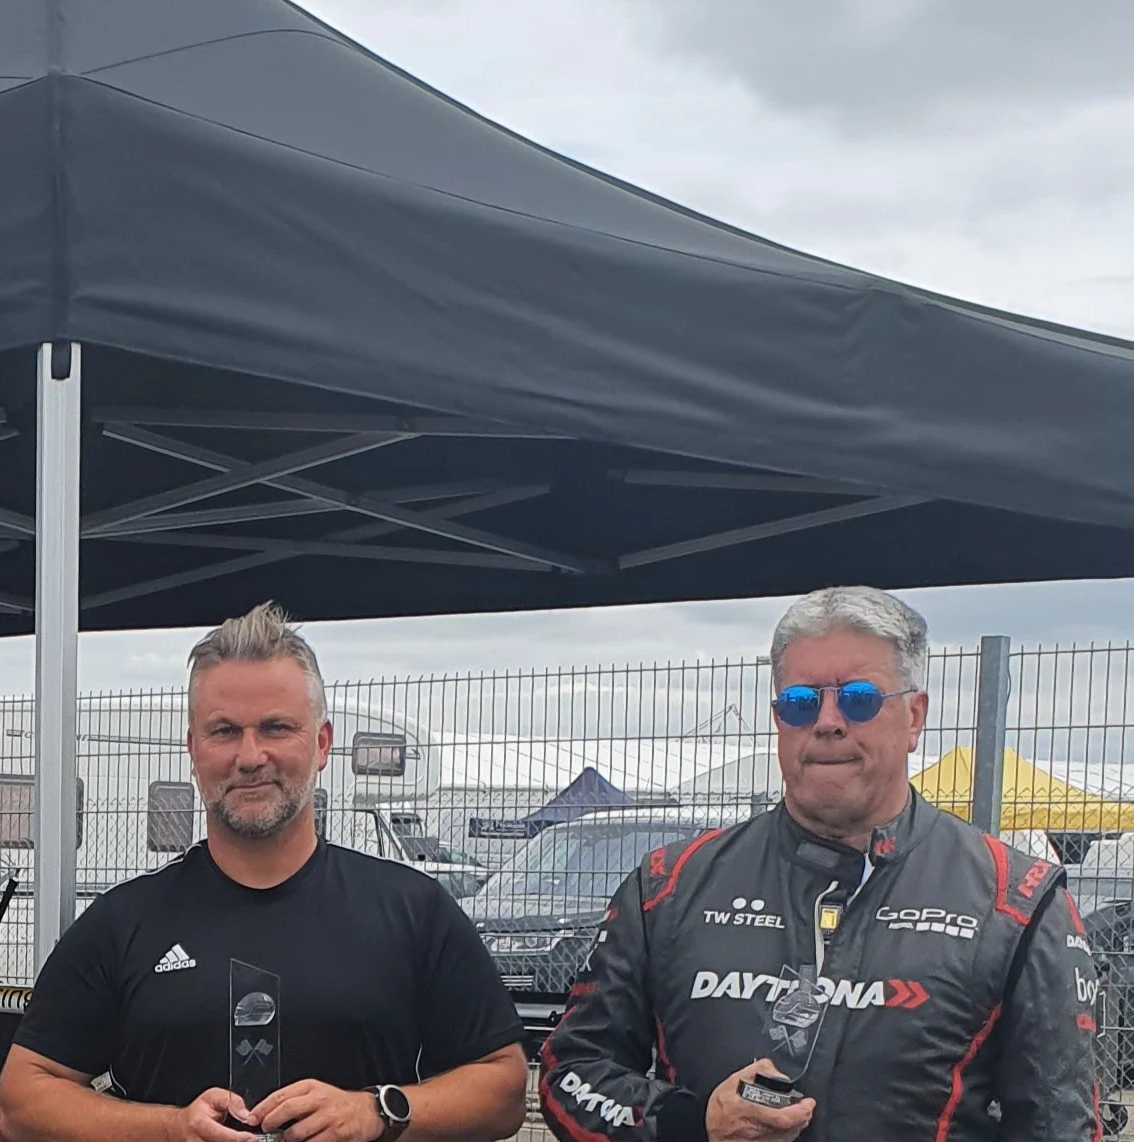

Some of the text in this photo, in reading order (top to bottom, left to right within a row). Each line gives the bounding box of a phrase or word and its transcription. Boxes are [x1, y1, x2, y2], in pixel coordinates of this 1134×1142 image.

[703, 910, 785, 929] TW STEEL
[875, 906, 978, 929] GoPro
[154, 959, 197, 973] adidas
